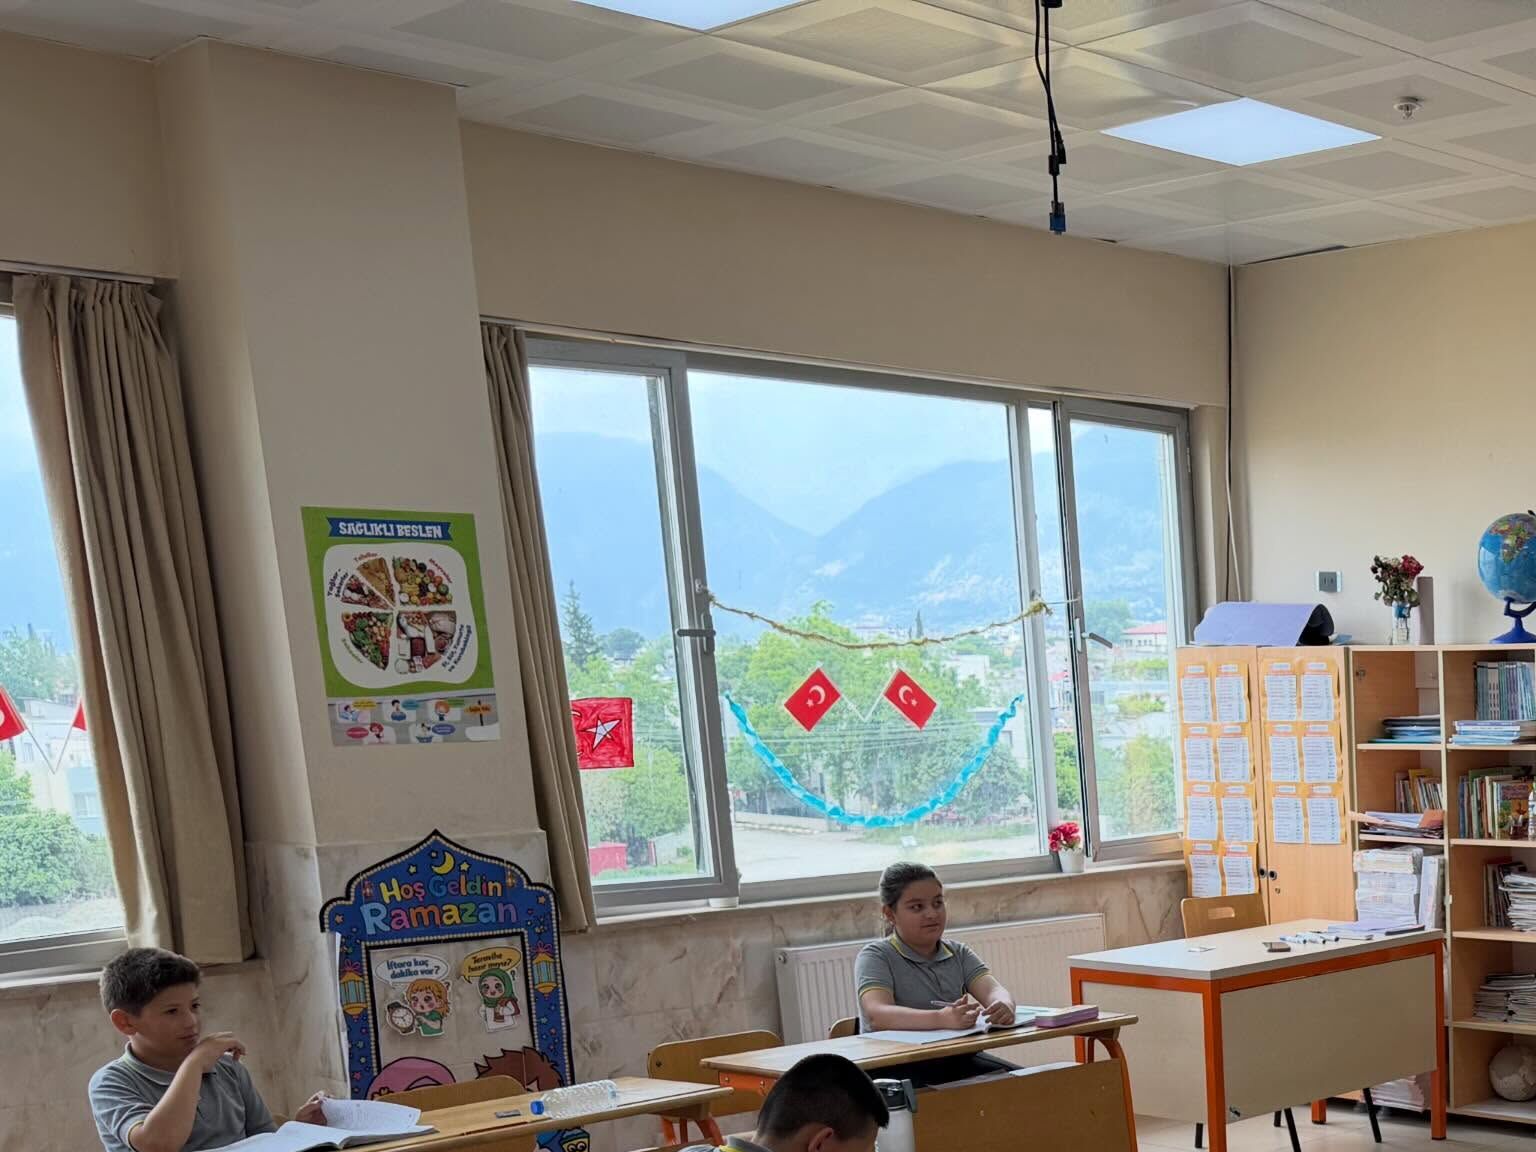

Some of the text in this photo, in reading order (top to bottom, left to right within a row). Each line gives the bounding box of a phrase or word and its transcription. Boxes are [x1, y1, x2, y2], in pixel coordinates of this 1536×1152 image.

[338, 521, 443, 538] SAĞLIKLI BESLEN
[379, 871, 503, 904] Hoş Geldin
[360, 902, 518, 935] Ramazan
